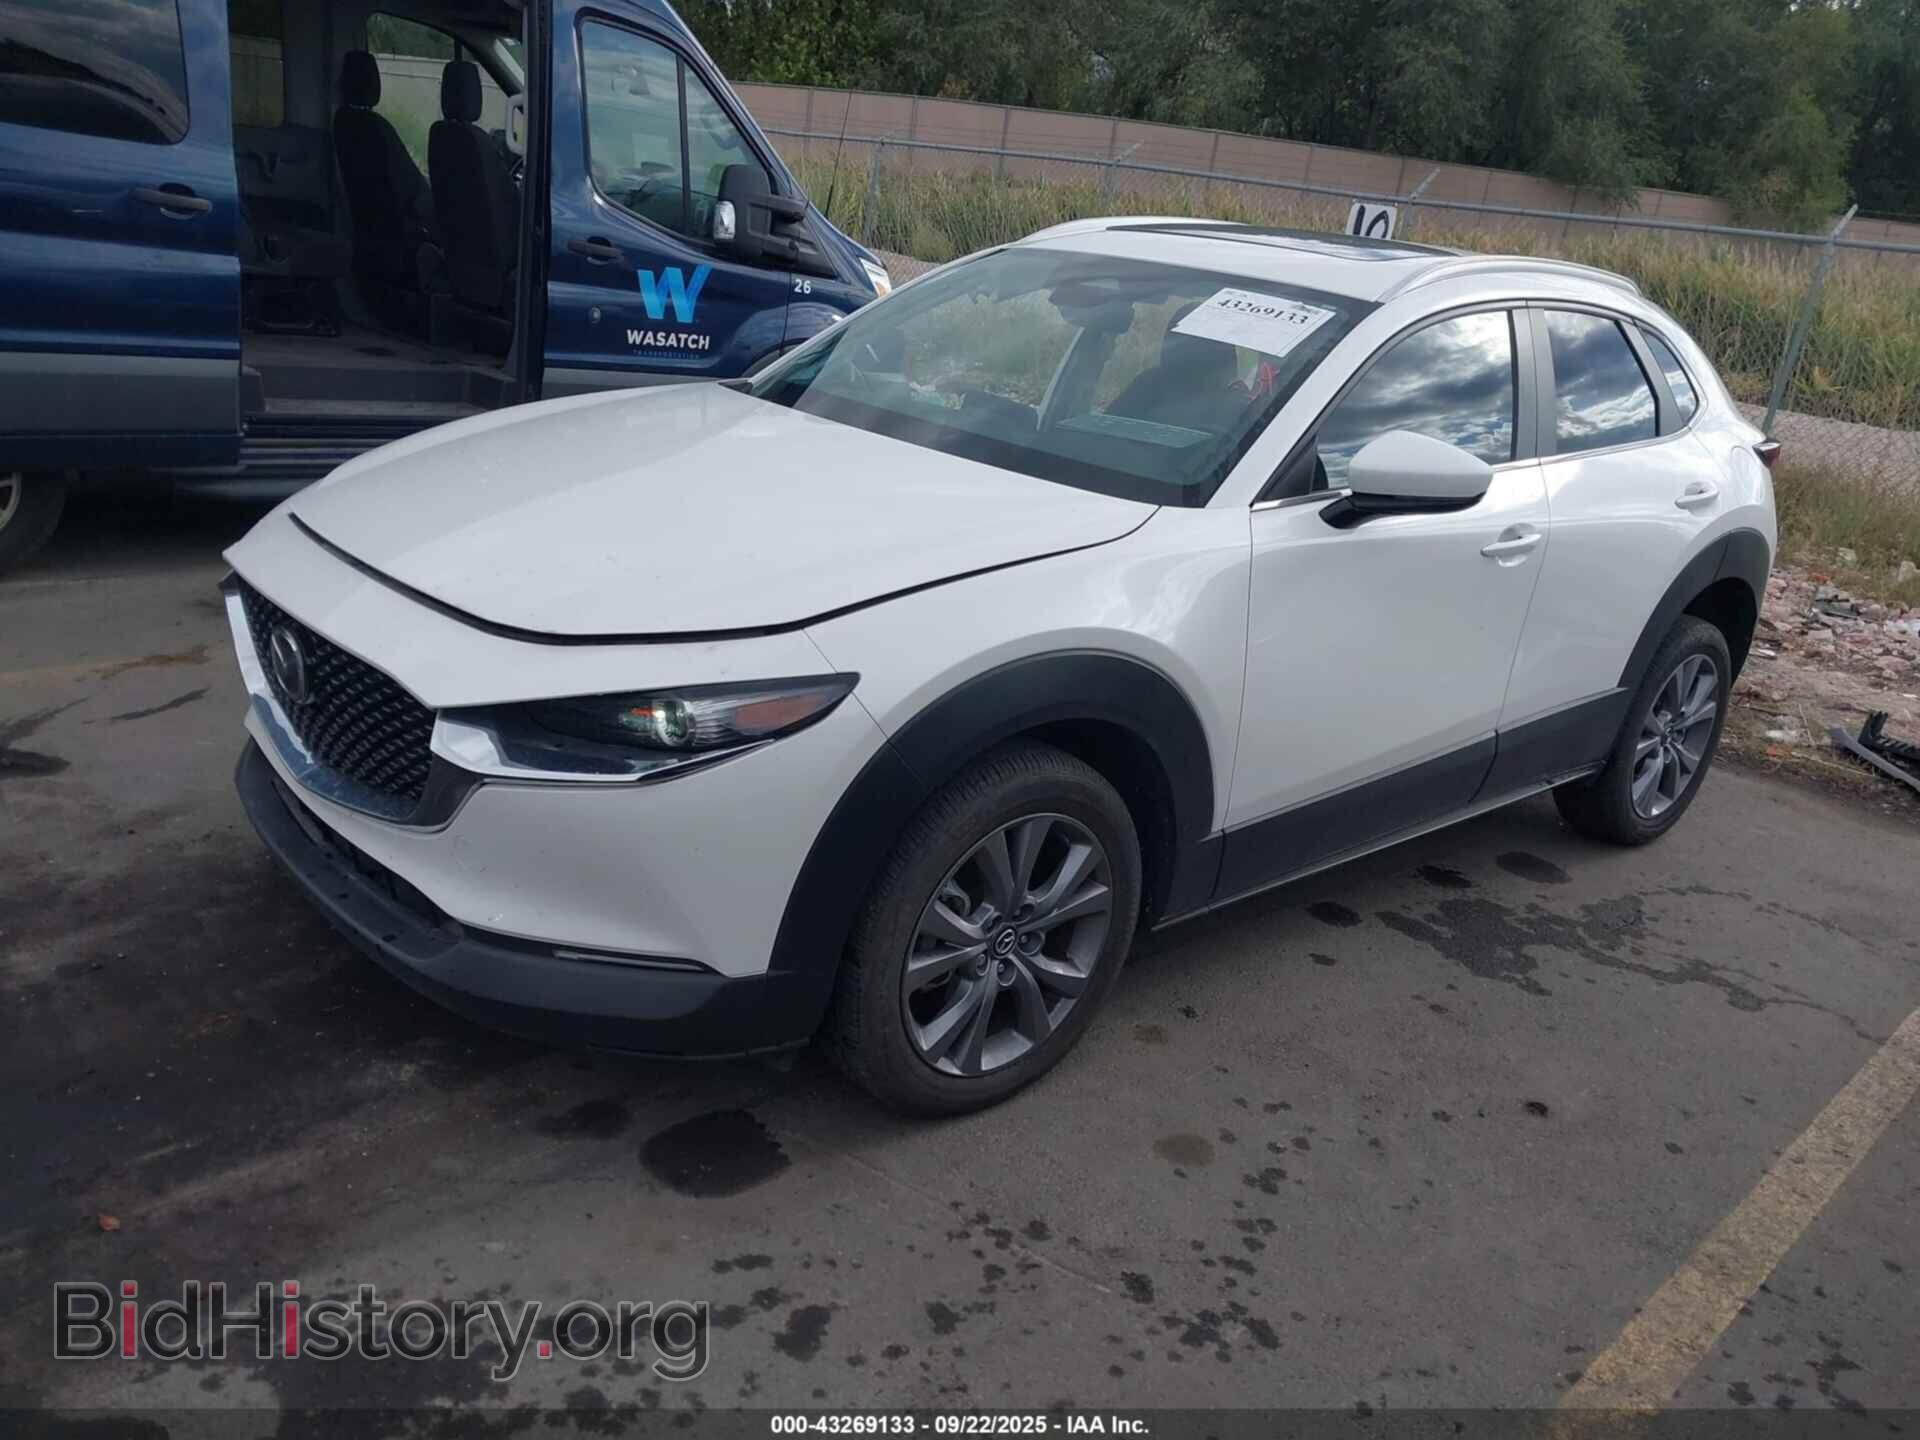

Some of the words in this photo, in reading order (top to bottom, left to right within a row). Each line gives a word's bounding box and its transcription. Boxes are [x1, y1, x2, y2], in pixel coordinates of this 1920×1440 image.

[638, 262, 713, 323] W
[794, 279, 811, 294] 26
[1217, 298, 1308, 324] 43269133
[627, 329, 710, 350] WASATCH
